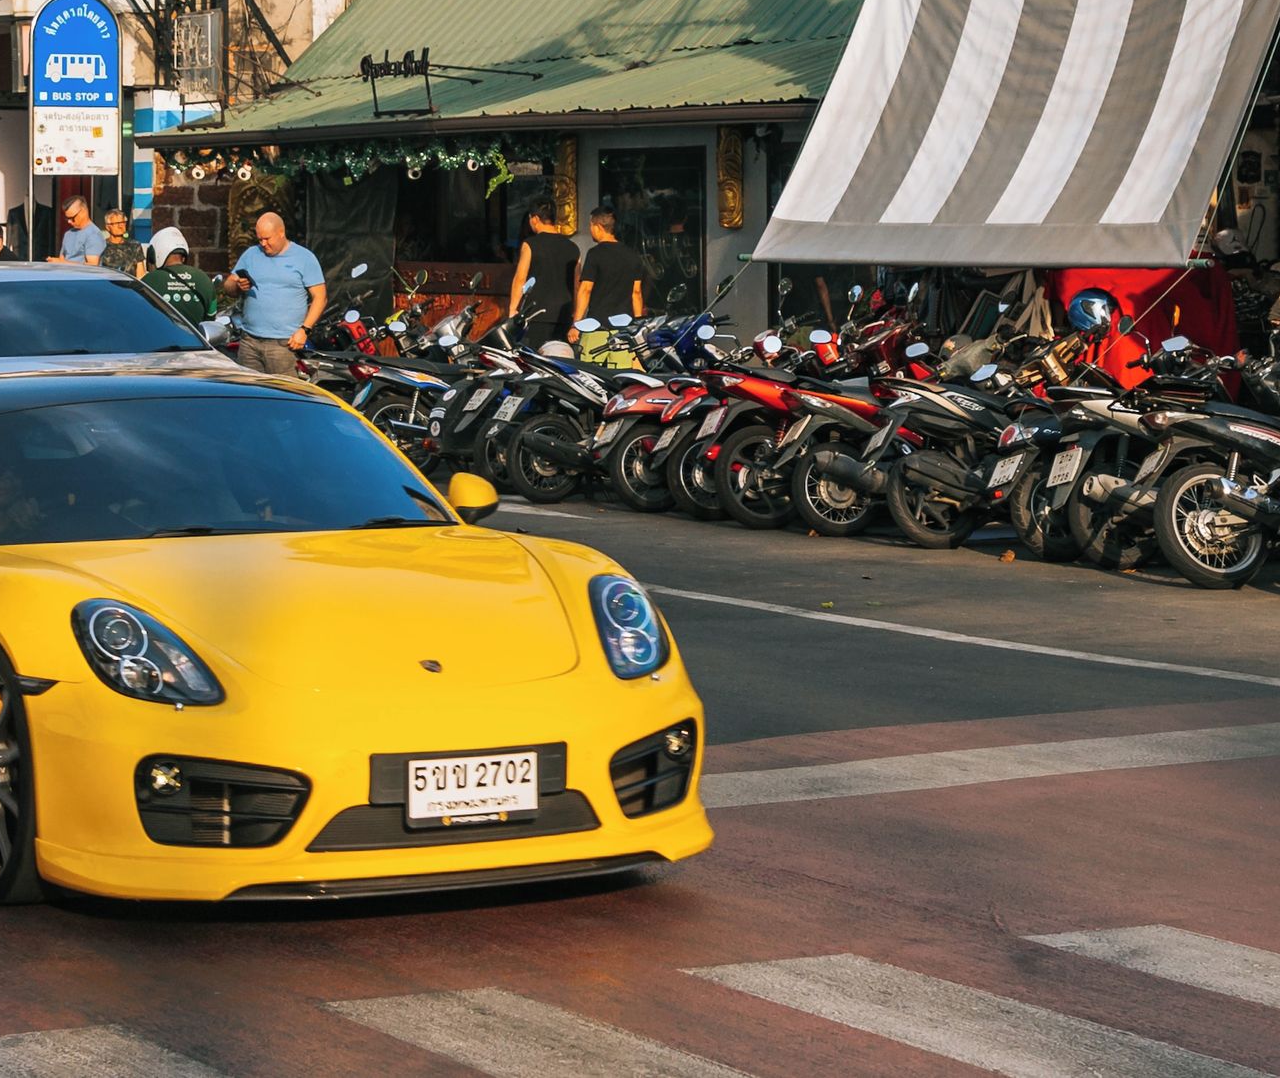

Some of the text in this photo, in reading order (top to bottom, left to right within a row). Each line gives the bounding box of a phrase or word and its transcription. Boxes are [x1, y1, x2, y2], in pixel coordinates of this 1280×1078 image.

[52, 92, 100, 101] BUS STOP
[475, 758, 532, 788] 2702
